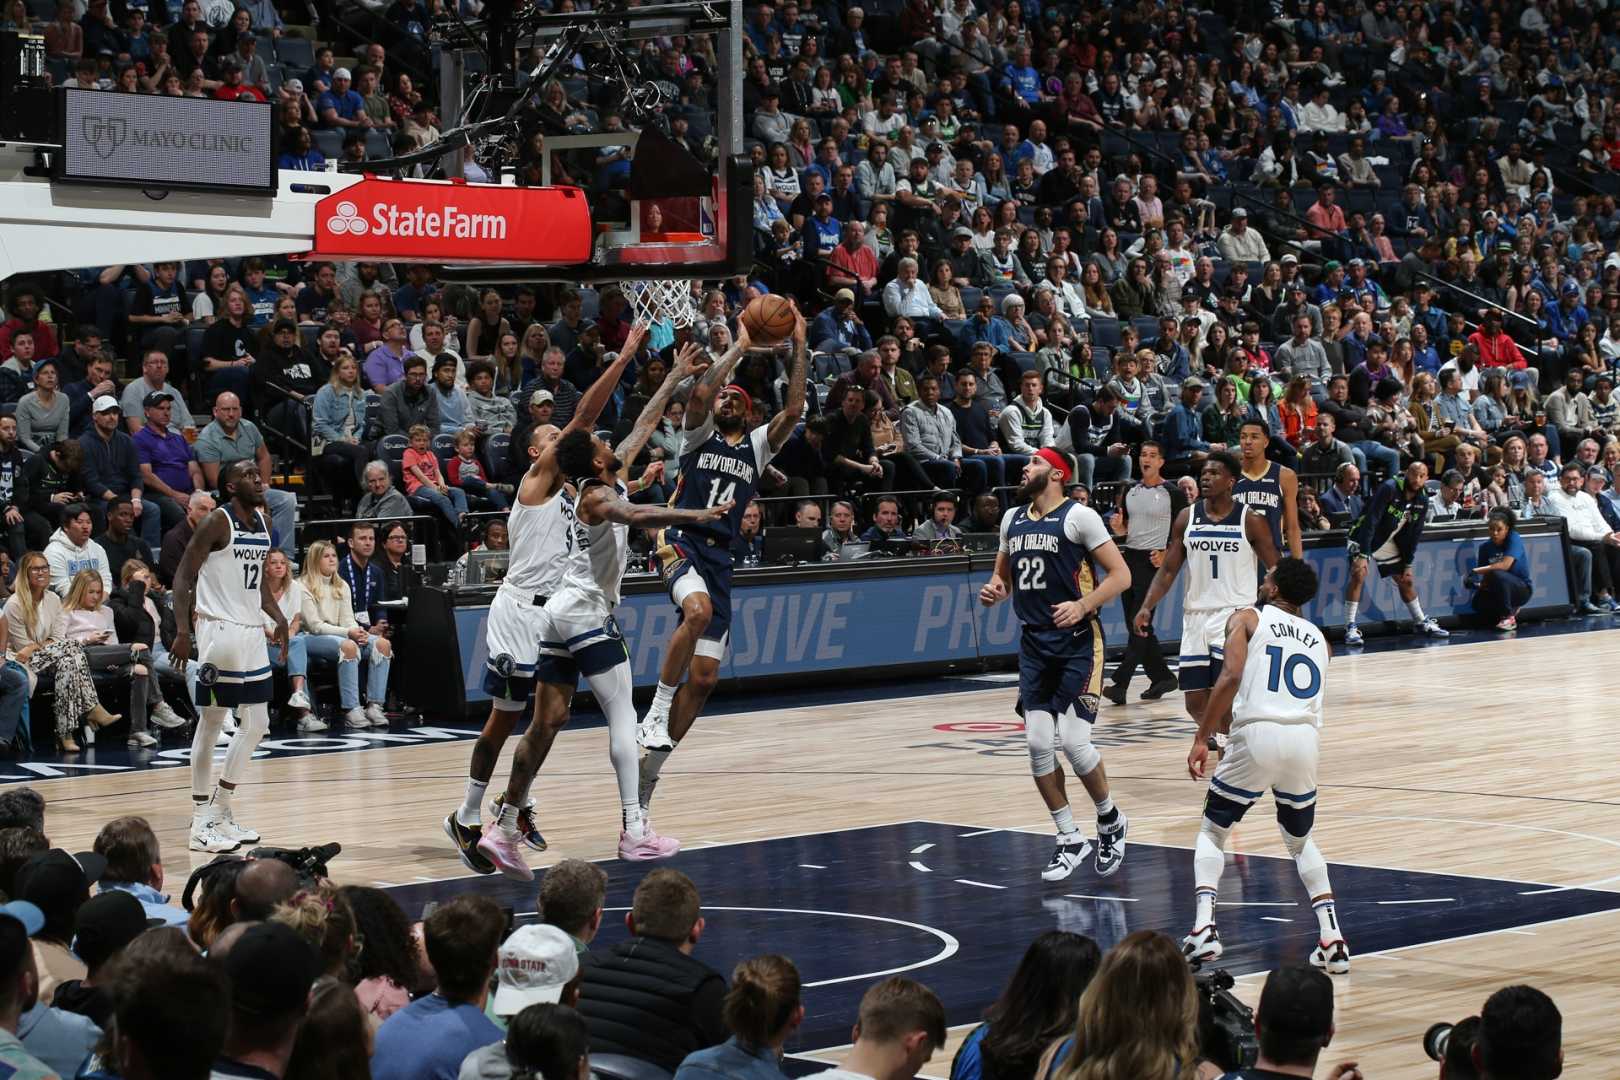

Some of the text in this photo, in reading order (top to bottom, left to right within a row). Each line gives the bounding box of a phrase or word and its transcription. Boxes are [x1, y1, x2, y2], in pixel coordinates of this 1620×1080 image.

[133, 129, 253, 152] MAYO CLINIC
[372, 202, 506, 239] State Farm
[697, 452, 753, 485] NEW ORLEANS
[706, 477, 736, 510] 14
[233, 549, 266, 560] WOLVE
[1024, 533, 1059, 553] ORLEANS
[1189, 540, 1240, 553] WOLVES
[243, 564, 259, 590] 12
[1018, 556, 1047, 590] 22
[1209, 554, 1218, 579] 1
[1270, 622, 1320, 648] CONLEY
[1265, 644, 1321, 700] 10
